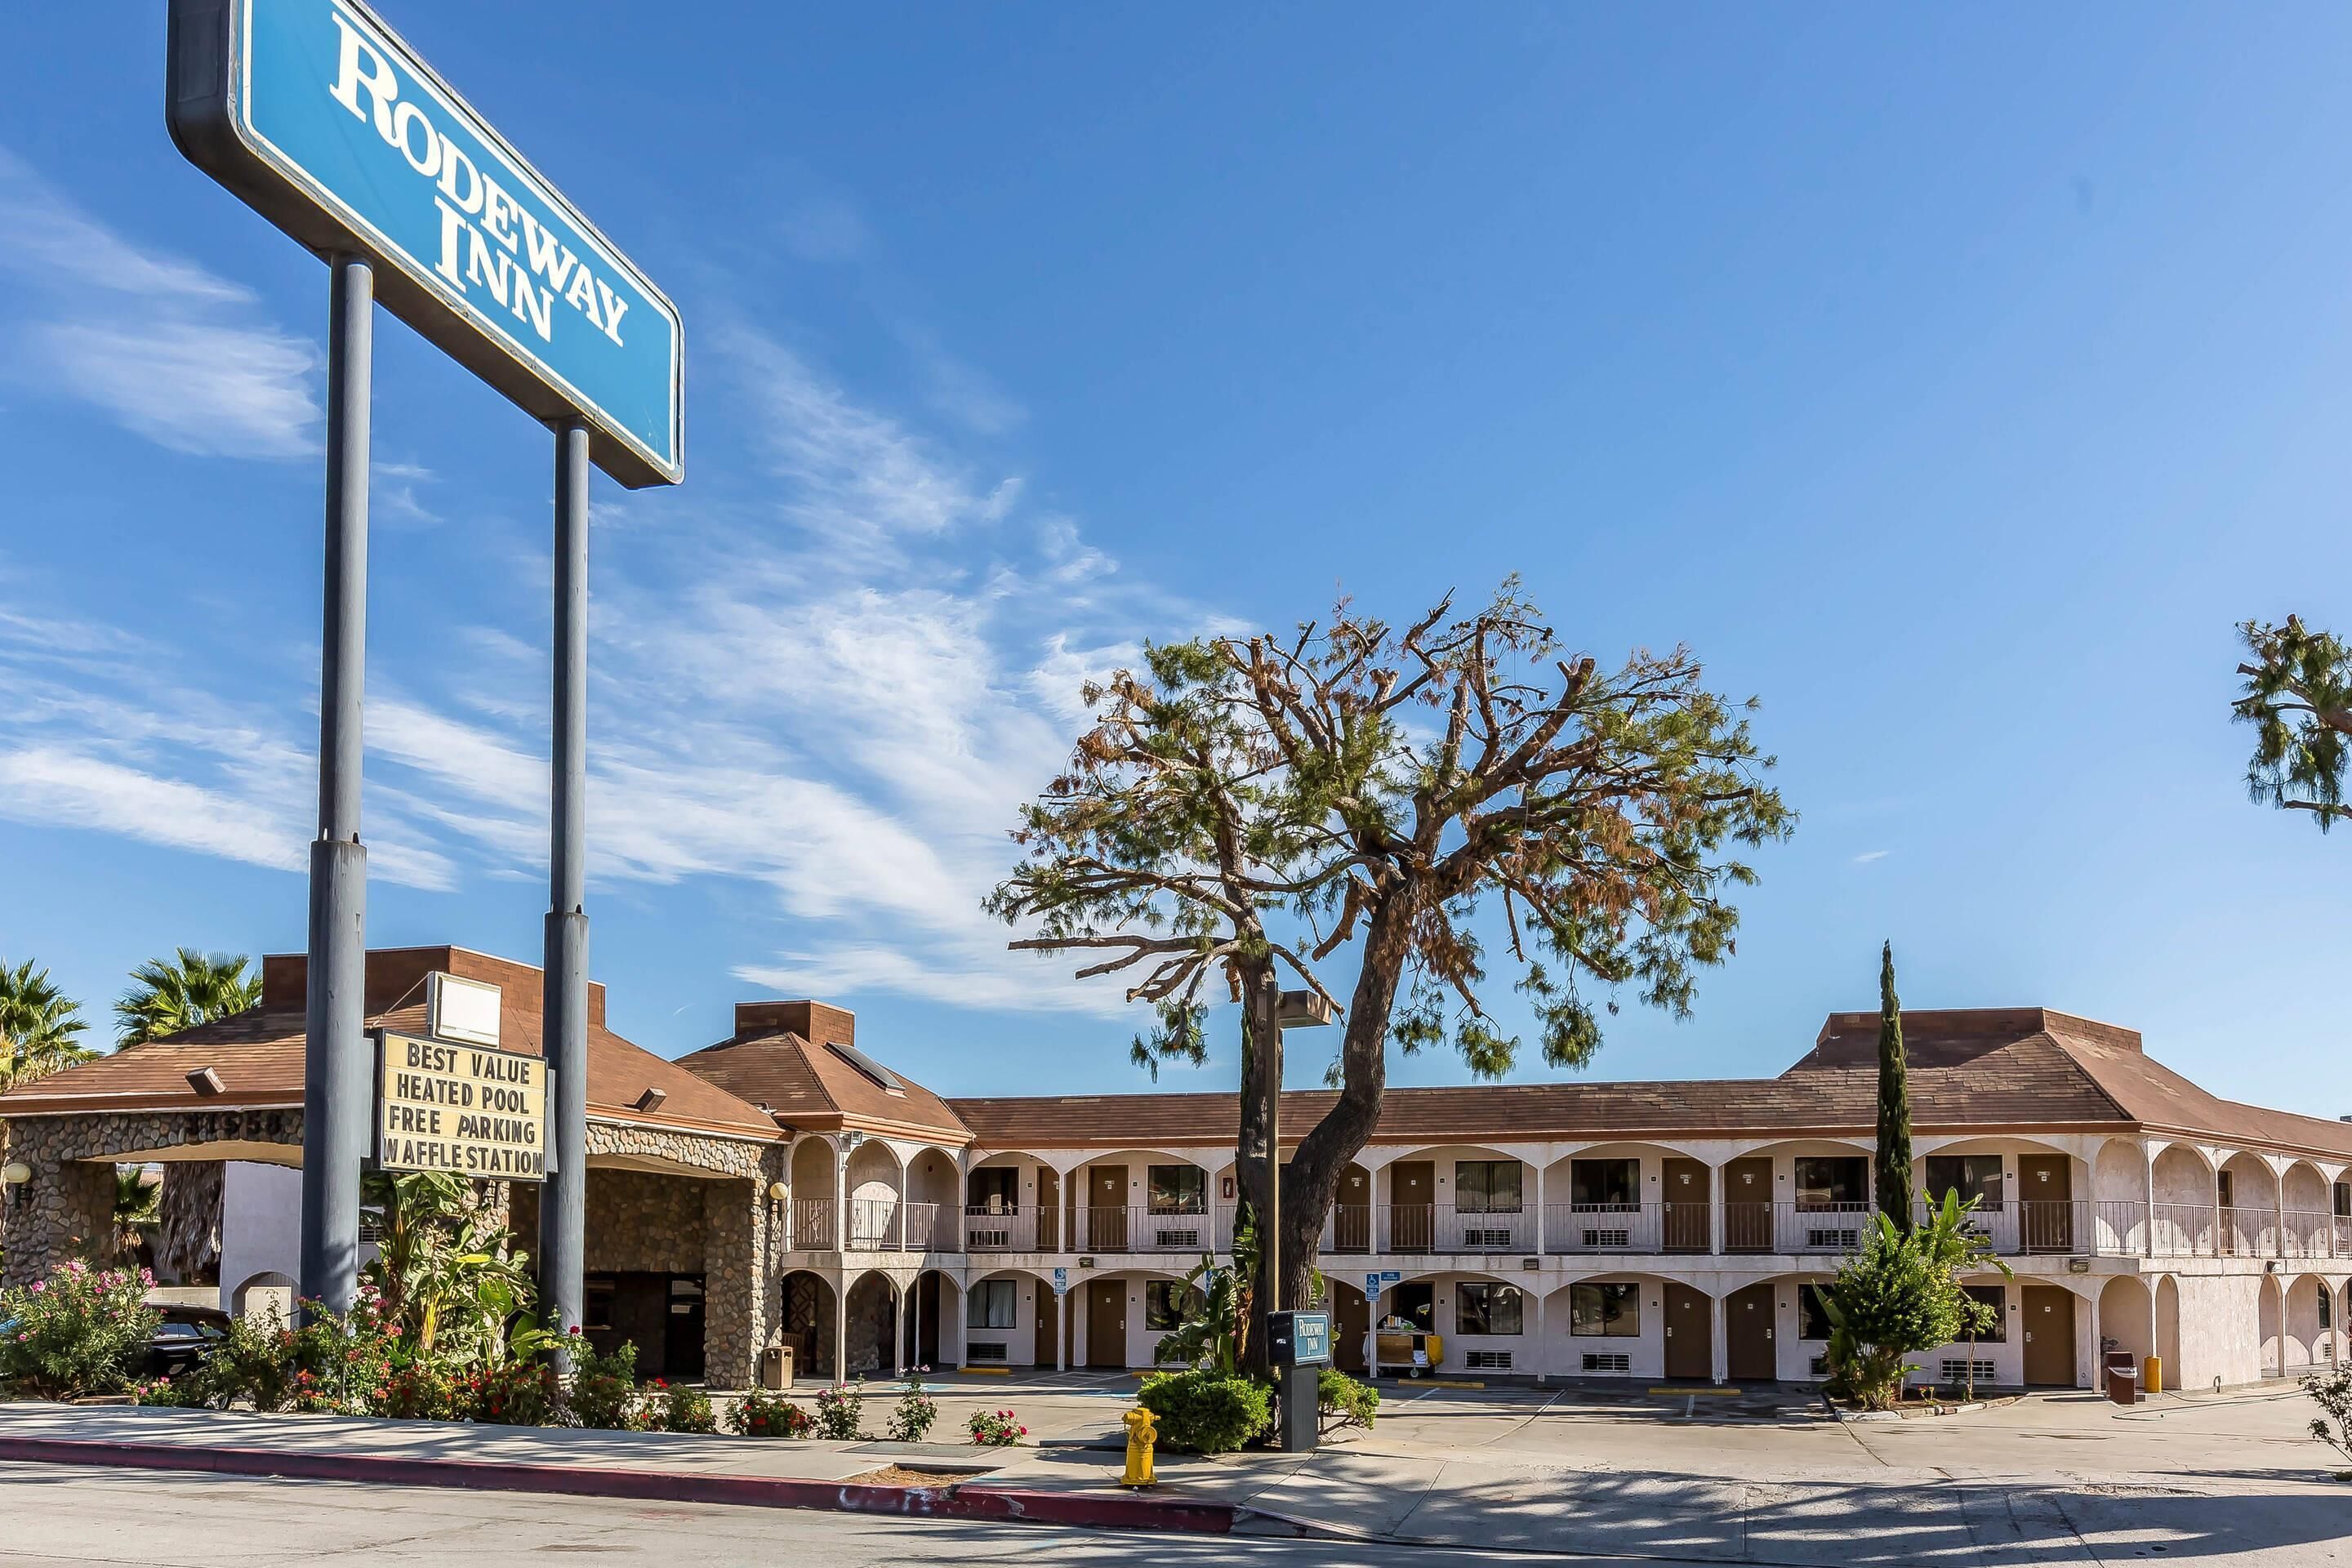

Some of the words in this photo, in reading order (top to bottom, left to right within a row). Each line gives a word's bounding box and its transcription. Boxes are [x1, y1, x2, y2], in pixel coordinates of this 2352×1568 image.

[329, 11, 629, 347] RODEWAY
[434, 194, 555, 344] INN
[408, 1042, 458, 1073] BEST
[471, 1053, 530, 1085] VALUE
[397, 1073, 473, 1107] HEATED
[482, 1086, 529, 1115] POOL
[390, 1106, 441, 1134] FREE
[457, 1115, 535, 1144] PARKING
[384, 1138, 462, 1168] WAFFLE
[466, 1146, 542, 1175] STATION
[1298, 1319, 1325, 1337] RODEWAY
[1307, 1338, 1318, 1356] INN
